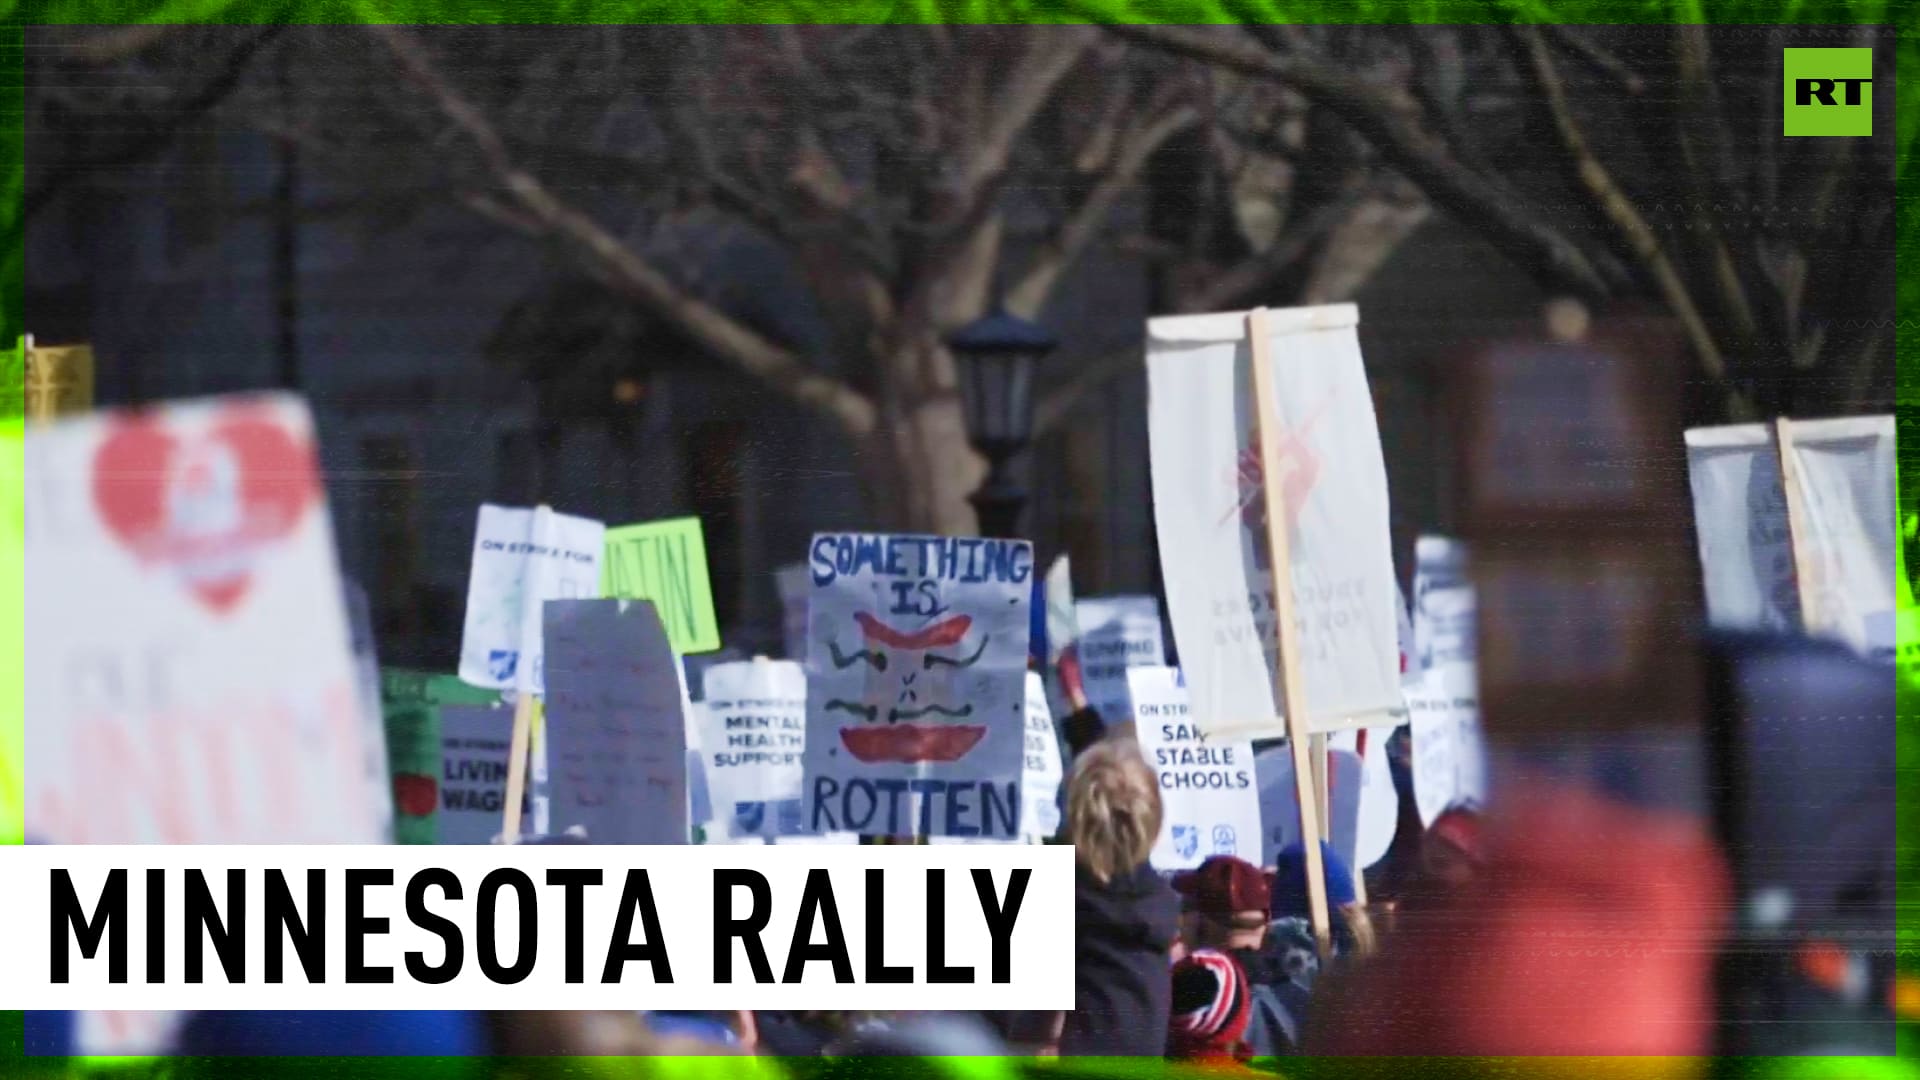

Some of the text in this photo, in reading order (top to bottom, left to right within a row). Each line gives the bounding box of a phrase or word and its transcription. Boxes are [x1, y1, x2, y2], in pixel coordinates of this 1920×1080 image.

[811, 536, 1033, 587] SOMETHING
[890, 580, 948, 616] IS
[1140, 704, 1159, 717] ON
[728, 733, 802, 748] HEALTH
[1156, 747, 1235, 766] STABLE
[1160, 770, 1250, 789] CHOOLS
[811, 776, 1018, 837] ROTTEN
